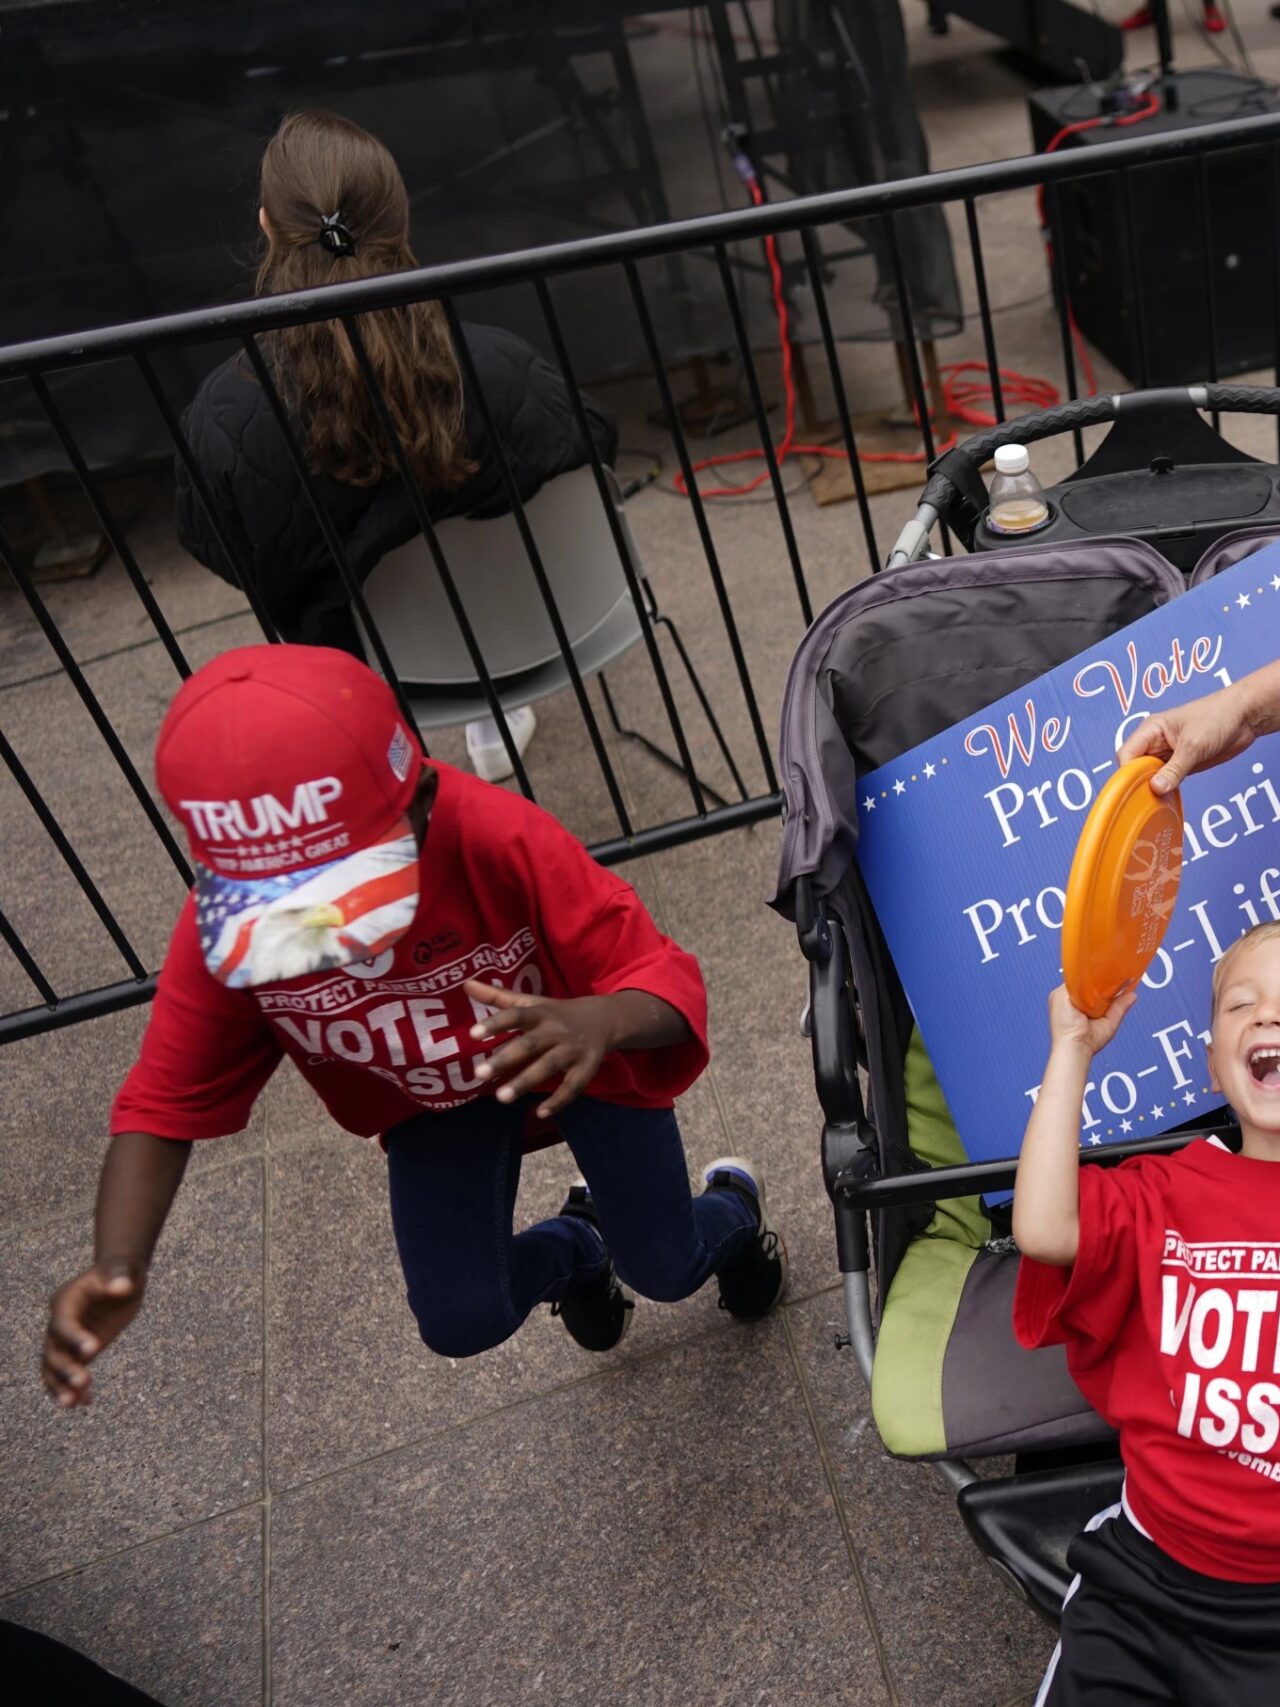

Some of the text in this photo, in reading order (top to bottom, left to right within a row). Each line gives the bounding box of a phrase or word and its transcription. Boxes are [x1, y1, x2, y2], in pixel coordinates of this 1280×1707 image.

[964, 634, 1224, 780] We Vote
[179, 775, 343, 842] TRUMP
[239, 849, 305, 873] AMERICA
[304, 832, 350, 860] GREAT
[260, 980, 359, 1011] PROTECT
[361, 963, 468, 994] PARENTS'
[471, 932, 536, 970] RIGHTS
[274, 997, 460, 1067] VOTE
[1163, 1237, 1247, 1271] PROTECT
